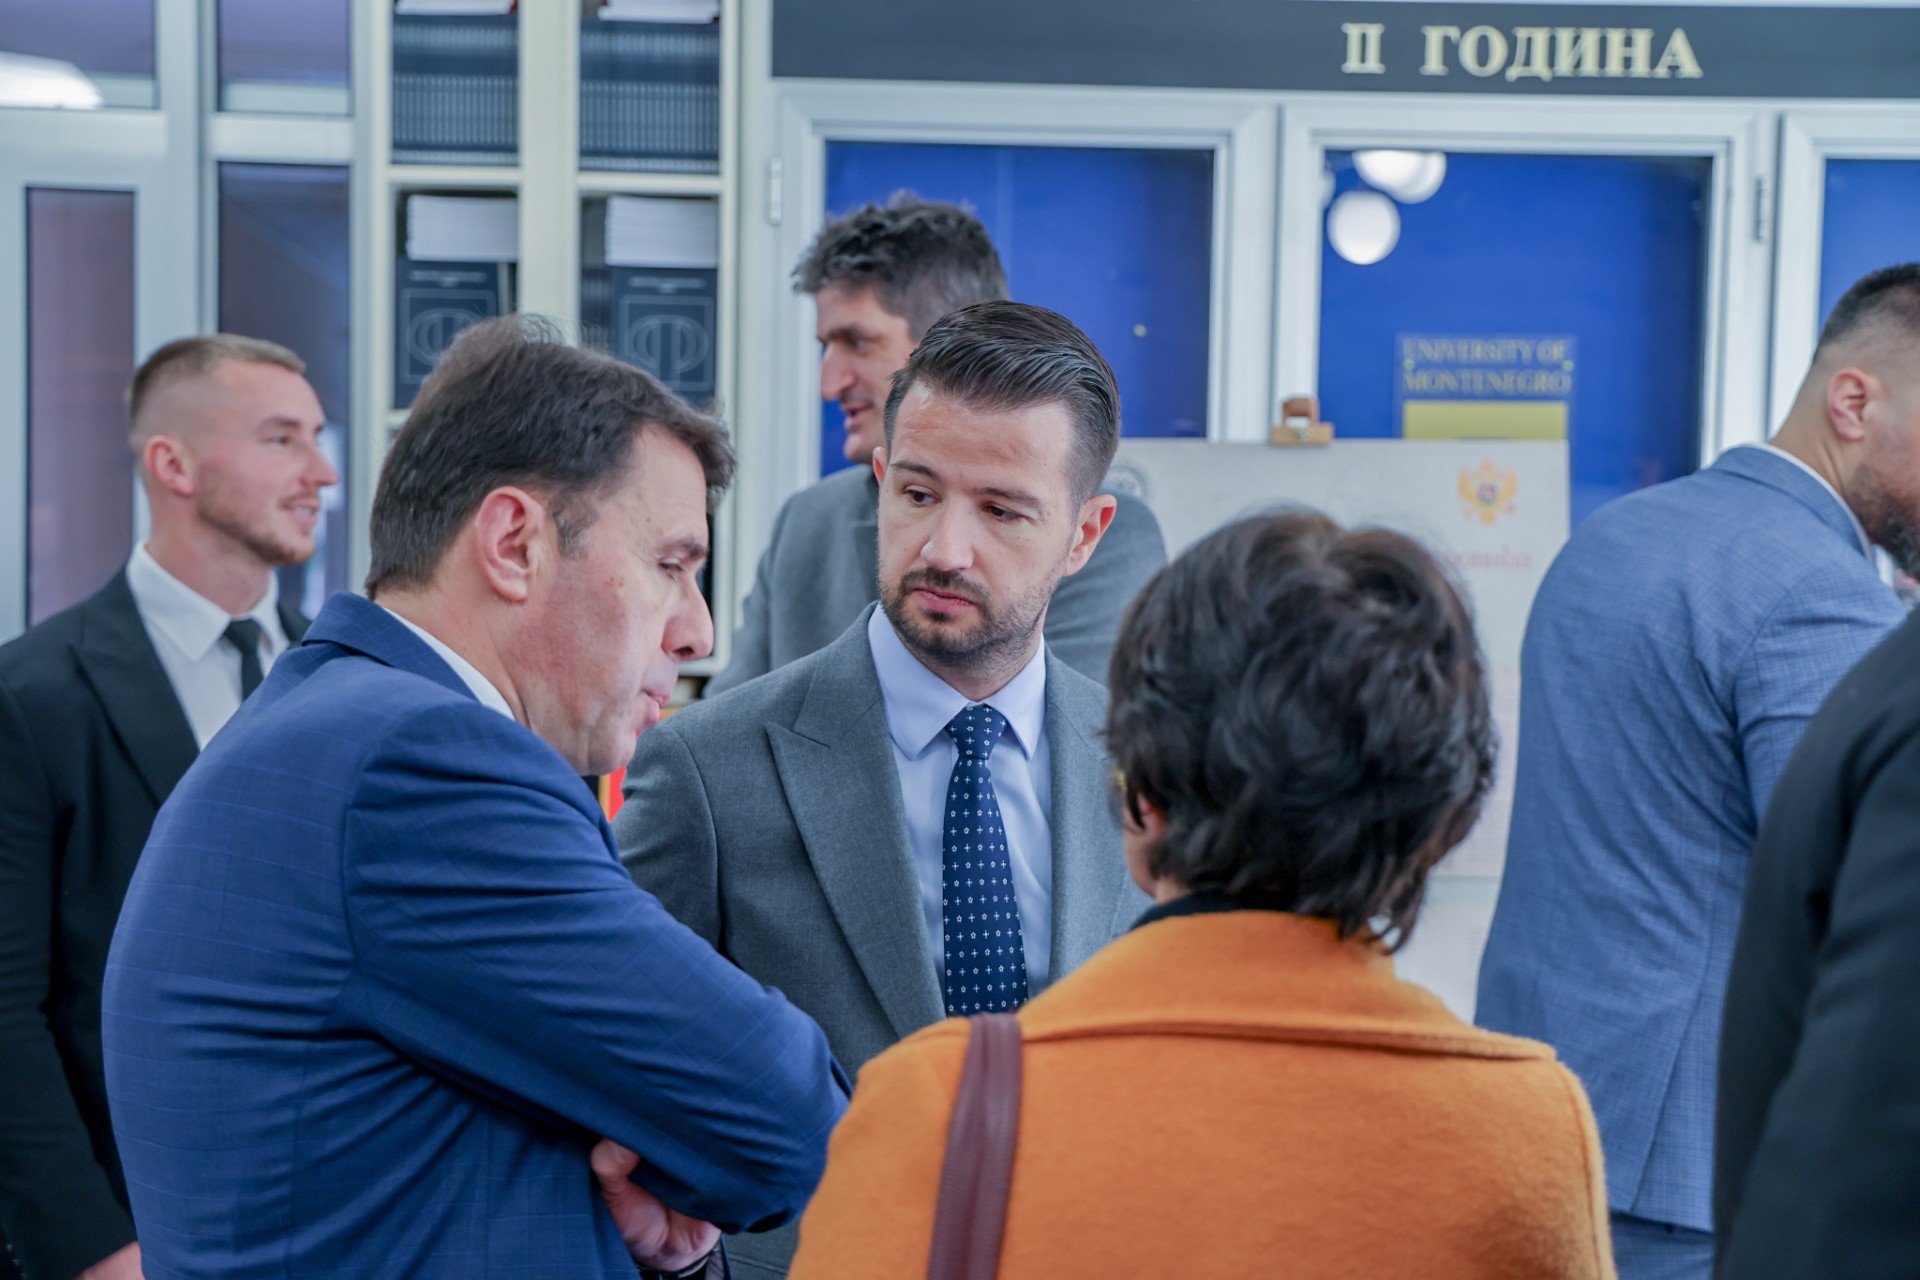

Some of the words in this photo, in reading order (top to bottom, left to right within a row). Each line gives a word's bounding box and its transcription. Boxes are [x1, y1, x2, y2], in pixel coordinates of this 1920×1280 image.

[1419, 25, 1704, 82] ГОДИНА
[1403, 338, 1533, 364] UNIVERSITY
[1536, 339, 1568, 365] OF
[1403, 368, 1572, 396] MONTENEGRO
